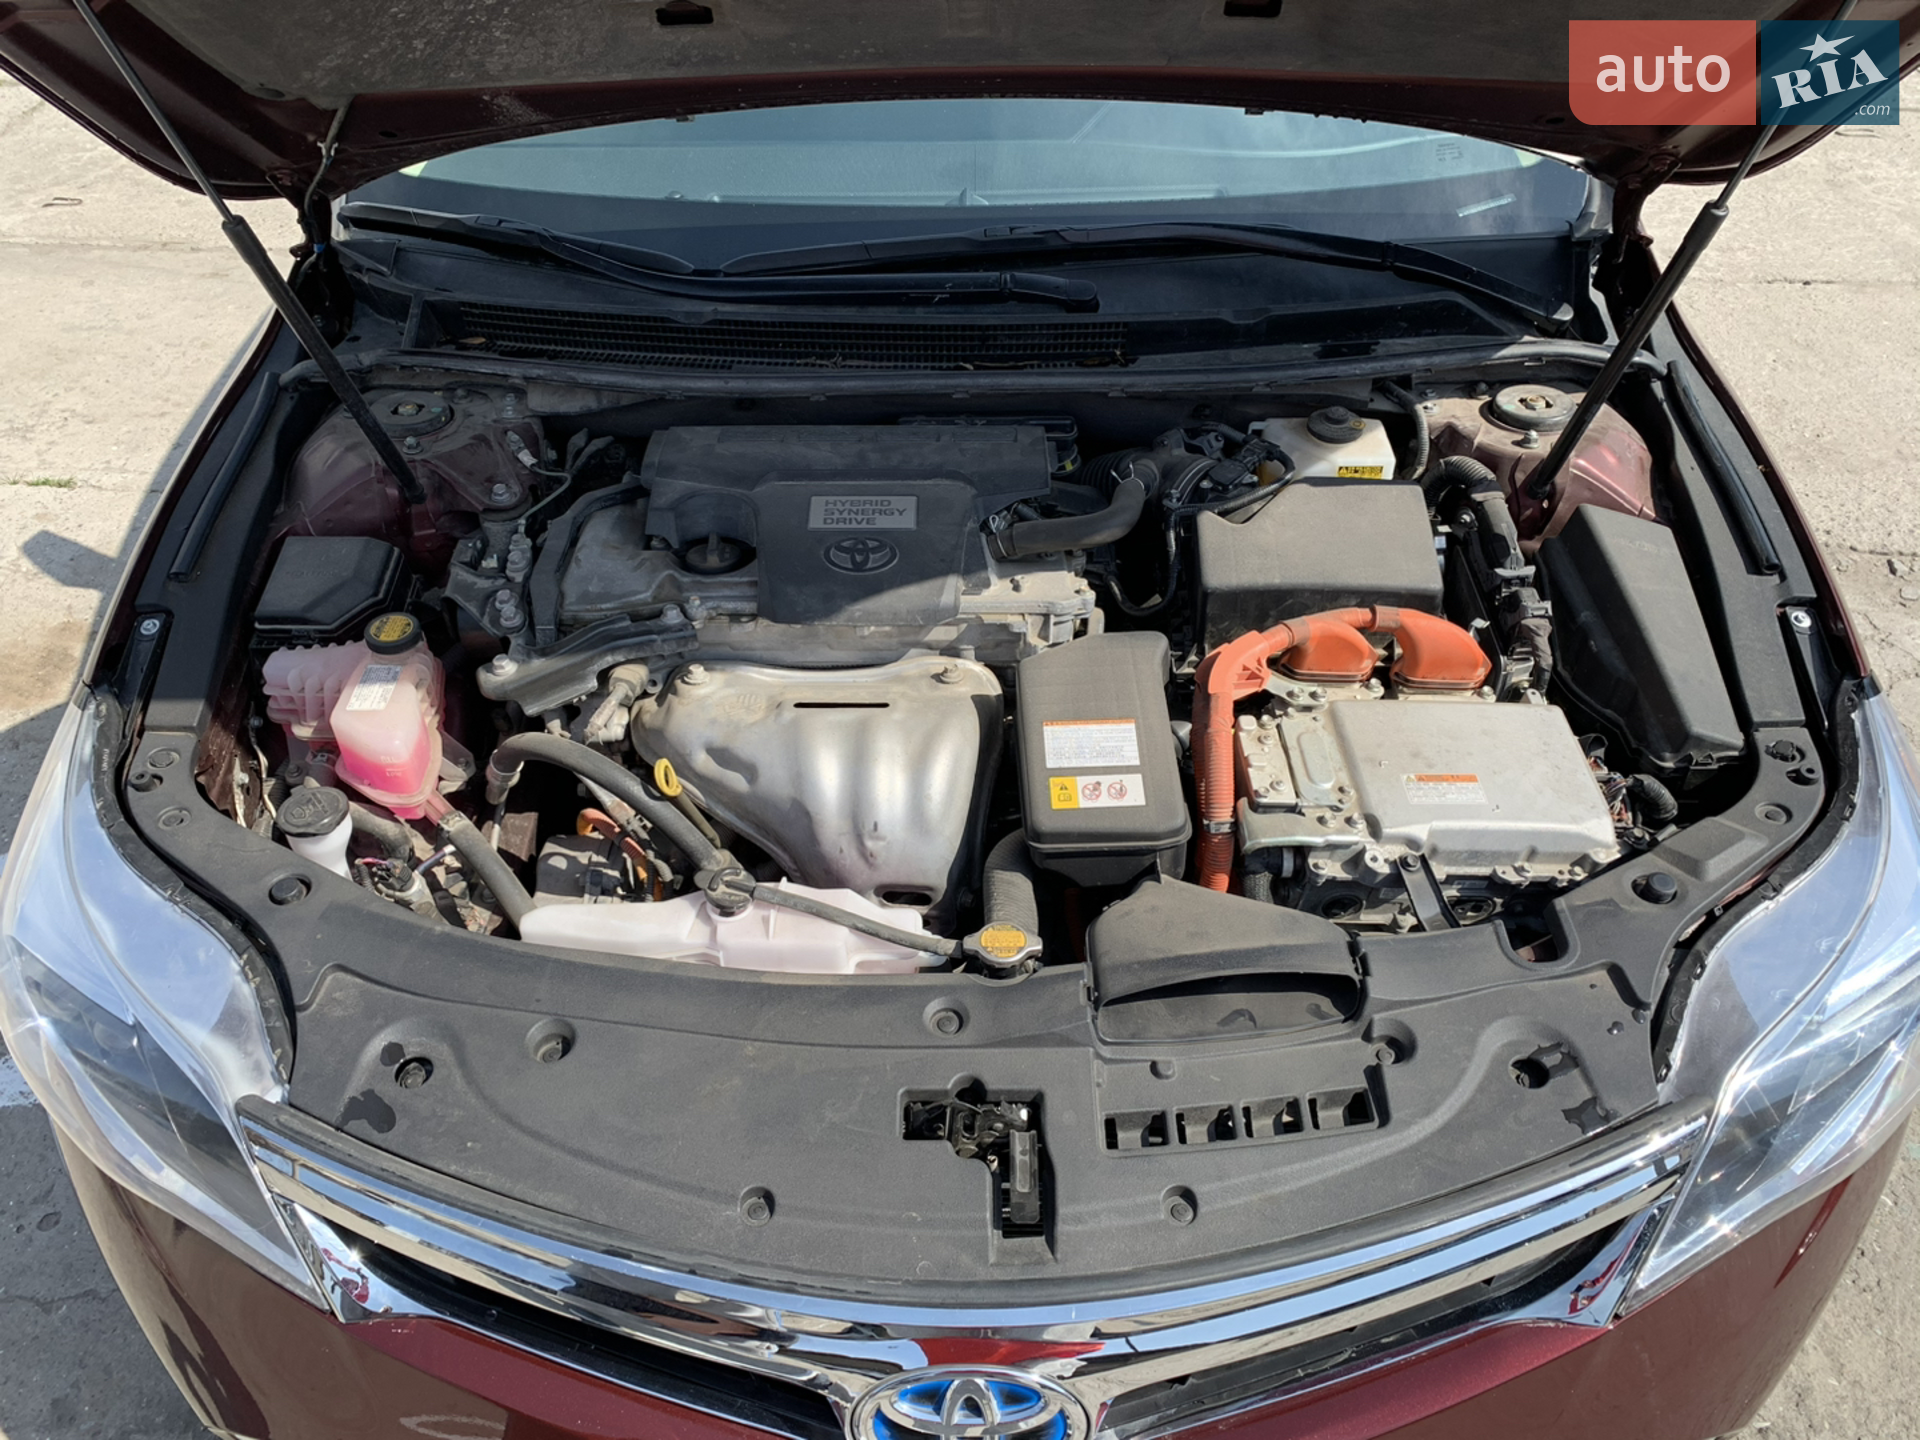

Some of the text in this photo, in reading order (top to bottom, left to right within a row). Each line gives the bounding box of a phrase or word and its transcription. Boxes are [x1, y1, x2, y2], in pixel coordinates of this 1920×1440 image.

[825, 499, 892, 507] HYBRID
[823, 508, 907, 516] SYNERGY
[823, 517, 877, 525] DRIVE
